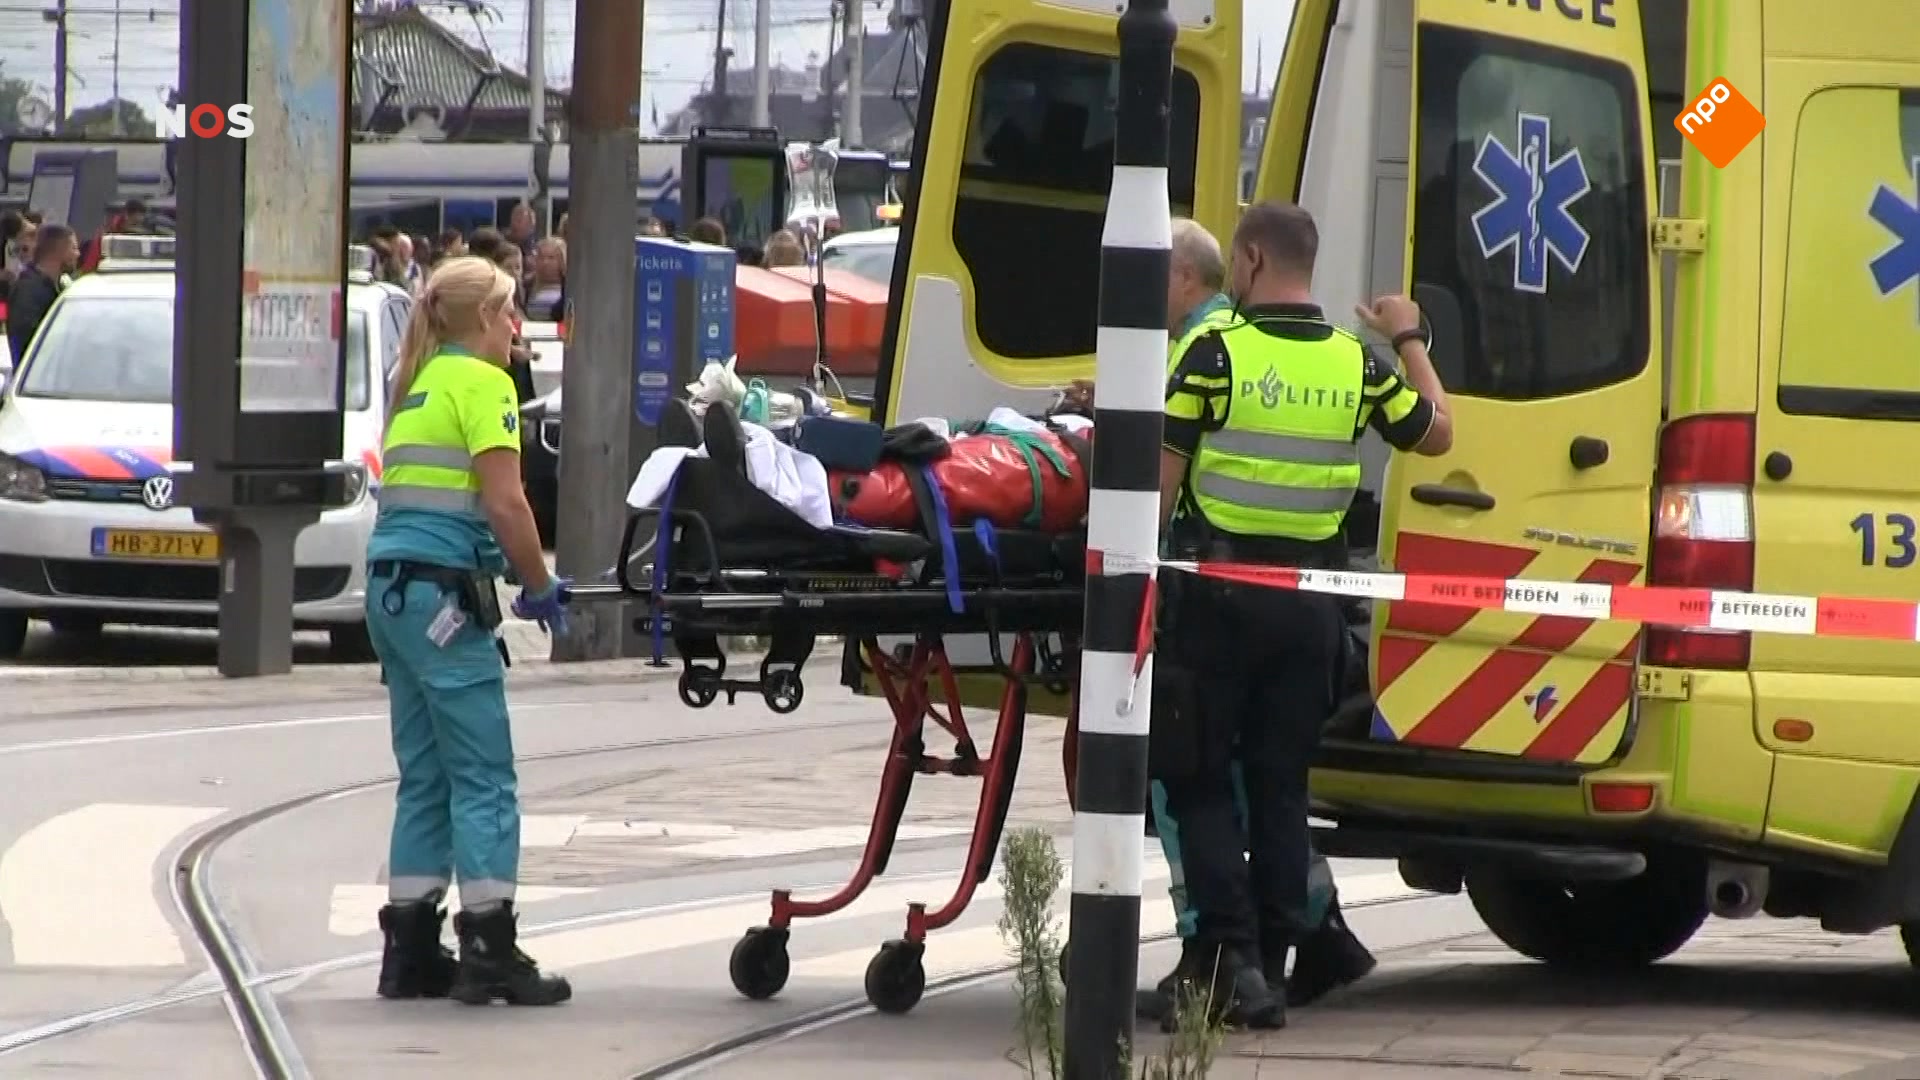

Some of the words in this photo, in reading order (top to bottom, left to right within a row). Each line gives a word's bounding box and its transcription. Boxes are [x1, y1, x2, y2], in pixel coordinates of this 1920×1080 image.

[111, 533, 205, 555] HB-371-V
[1849, 512, 1917, 568] 13
[1431, 583, 1468, 597] NIET
[1473, 586, 1559, 604] BETREDEN
[1679, 600, 1716, 612] NIET
[1721, 602, 1807, 617] BETREDEN
